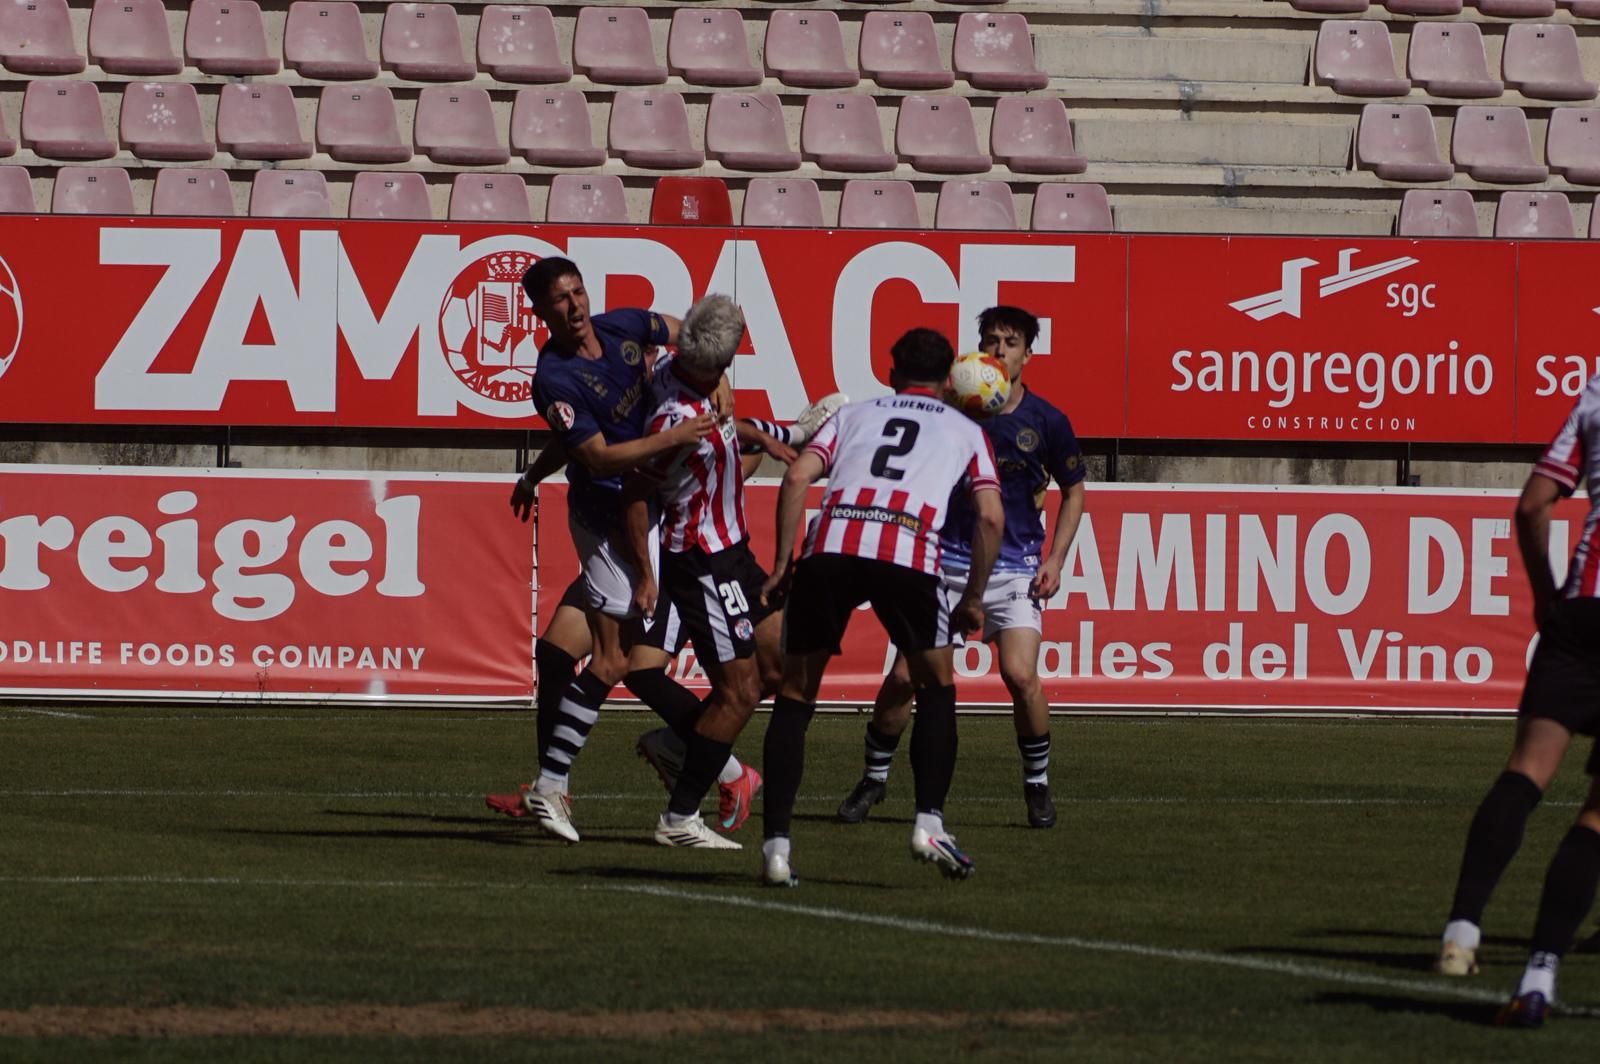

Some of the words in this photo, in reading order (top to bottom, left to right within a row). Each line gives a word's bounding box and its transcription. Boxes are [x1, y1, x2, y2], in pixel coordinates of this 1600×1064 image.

[1386, 282, 1436, 317] sgc
[1170, 340, 1494, 410] sangregorio
[892, 400, 945, 414] LUENGO
[1247, 415, 1417, 431] CONSTRUCCION
[870, 417, 920, 481] 2
[1040, 510, 1372, 616] AMINO
[1407, 516, 1511, 616] DE
[718, 580, 750, 617] 20
[120, 642, 236, 668] FOODS
[251, 644, 426, 671] COMPANY
[1202, 621, 1309, 681] del
[1337, 628, 1494, 684] Vino
